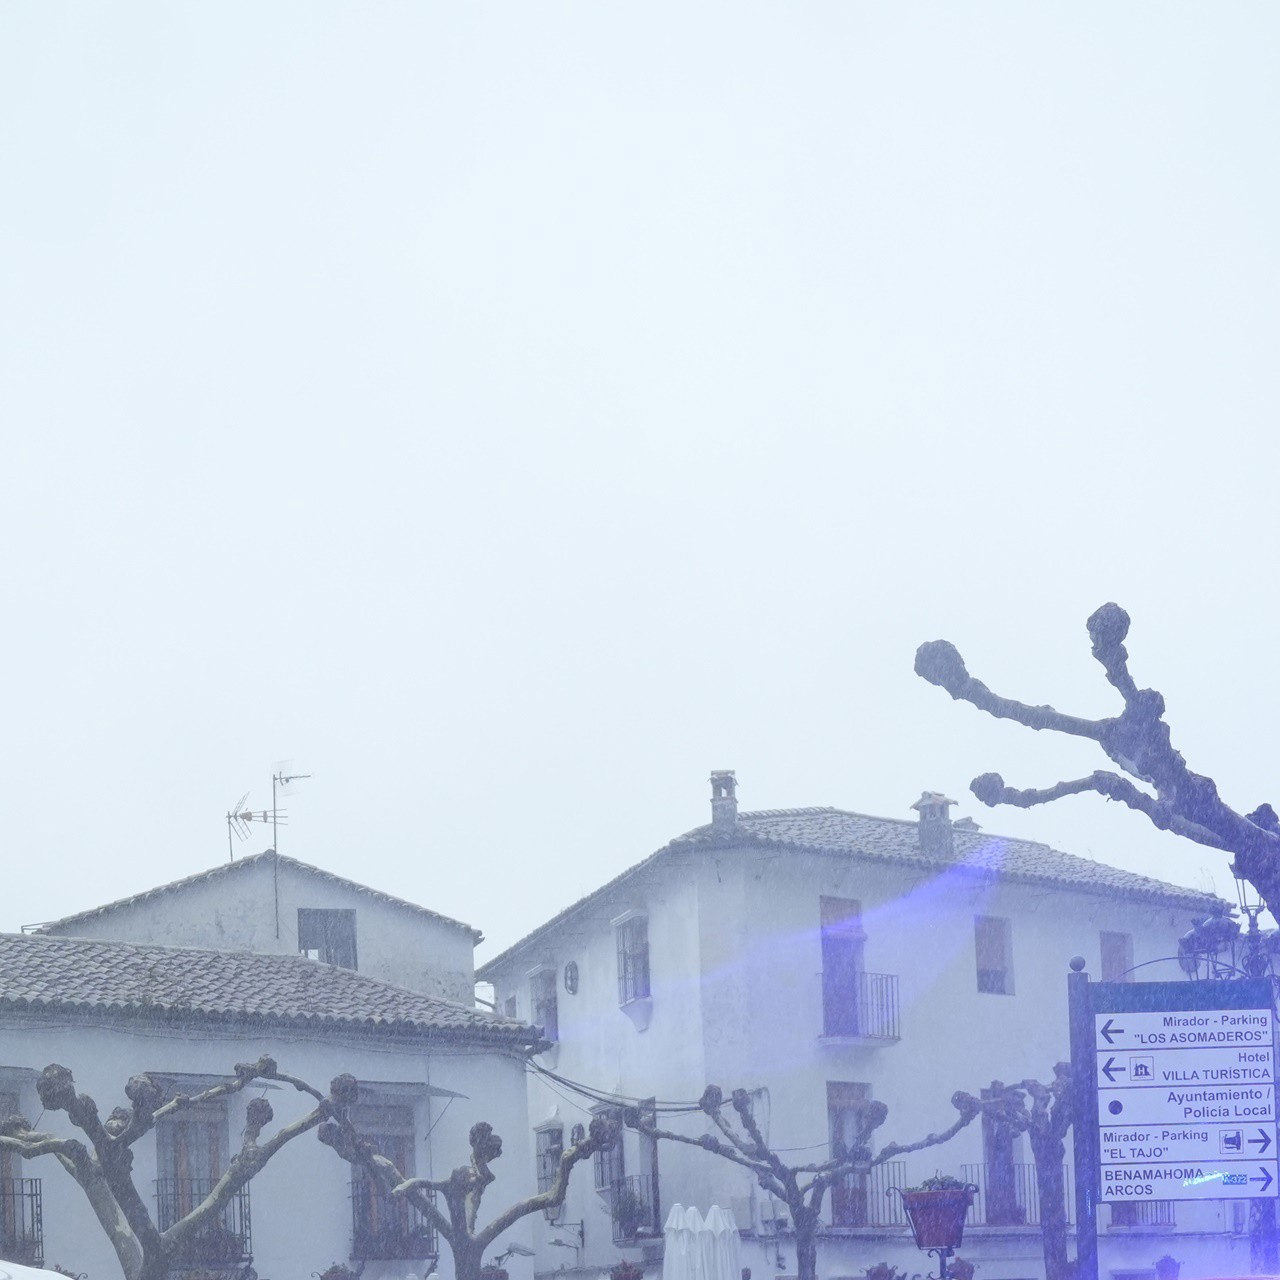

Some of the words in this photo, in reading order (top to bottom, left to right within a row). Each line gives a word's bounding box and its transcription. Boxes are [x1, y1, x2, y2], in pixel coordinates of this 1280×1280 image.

[1163, 1016, 1210, 1027] Mirador
[1221, 1014, 1268, 1027] Parking
[1134, 1033, 1166, 1044] "LOS
[1169, 1030, 1268, 1043] ASOMADEROS"
[1238, 1051, 1270, 1063] Hotel
[1162, 1070, 1200, 1081] VILLA
[1203, 1066, 1271, 1080] TURÍSTICA
[1167, 1088, 1263, 1105] Ayuntamiento
[1183, 1106, 1230, 1119] Policía
[1234, 1104, 1271, 1117] Local
[1103, 1132, 1151, 1143] Mirador
[1161, 1130, 1209, 1142] Parking
[1103, 1148, 1126, 1159] "EL
[1130, 1147, 1169, 1158] TAJO"
[1105, 1168, 1204, 1181] BENAMAHOMA
[1105, 1184, 1153, 1196] ARCOS
